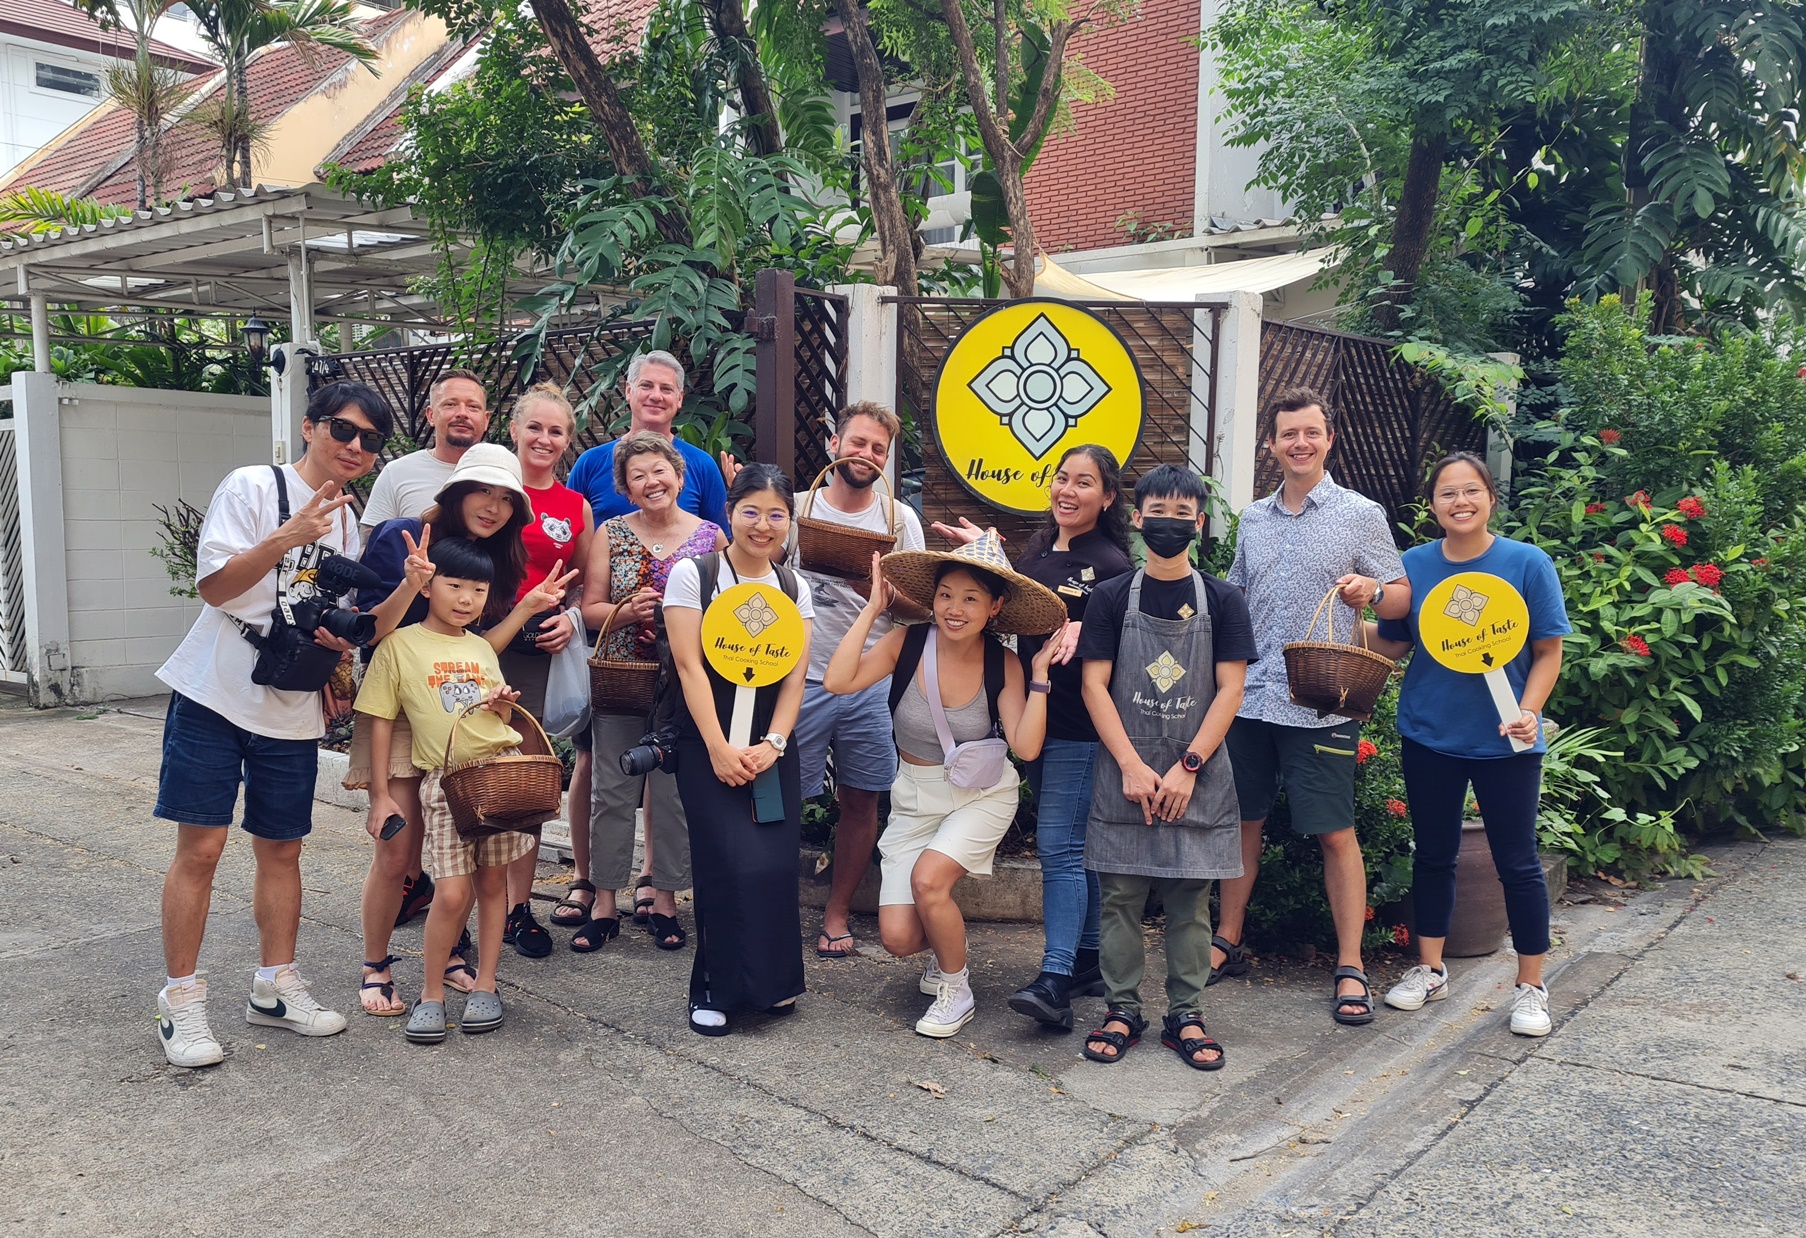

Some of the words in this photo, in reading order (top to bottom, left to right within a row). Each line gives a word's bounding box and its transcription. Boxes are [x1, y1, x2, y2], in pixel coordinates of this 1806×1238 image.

[966, 458, 1024, 485] House
[1031, 463, 1052, 488] of
[1441, 639, 1472, 652] House
[1476, 628, 1488, 642] of
[1489, 619, 1519, 635] Taste
[1467, 643, 1491, 654] Cooking
[1491, 636, 1511, 647] School
[714, 637, 746, 652] House
[749, 644, 761, 656] of
[765, 643, 791, 658] Taste
[735, 656, 759, 665] Cooking
[760, 657, 779, 667] School
[1133, 691, 1159, 708] House
[1160, 698, 1172, 712] of
[1176, 695, 1197, 711] Tate
